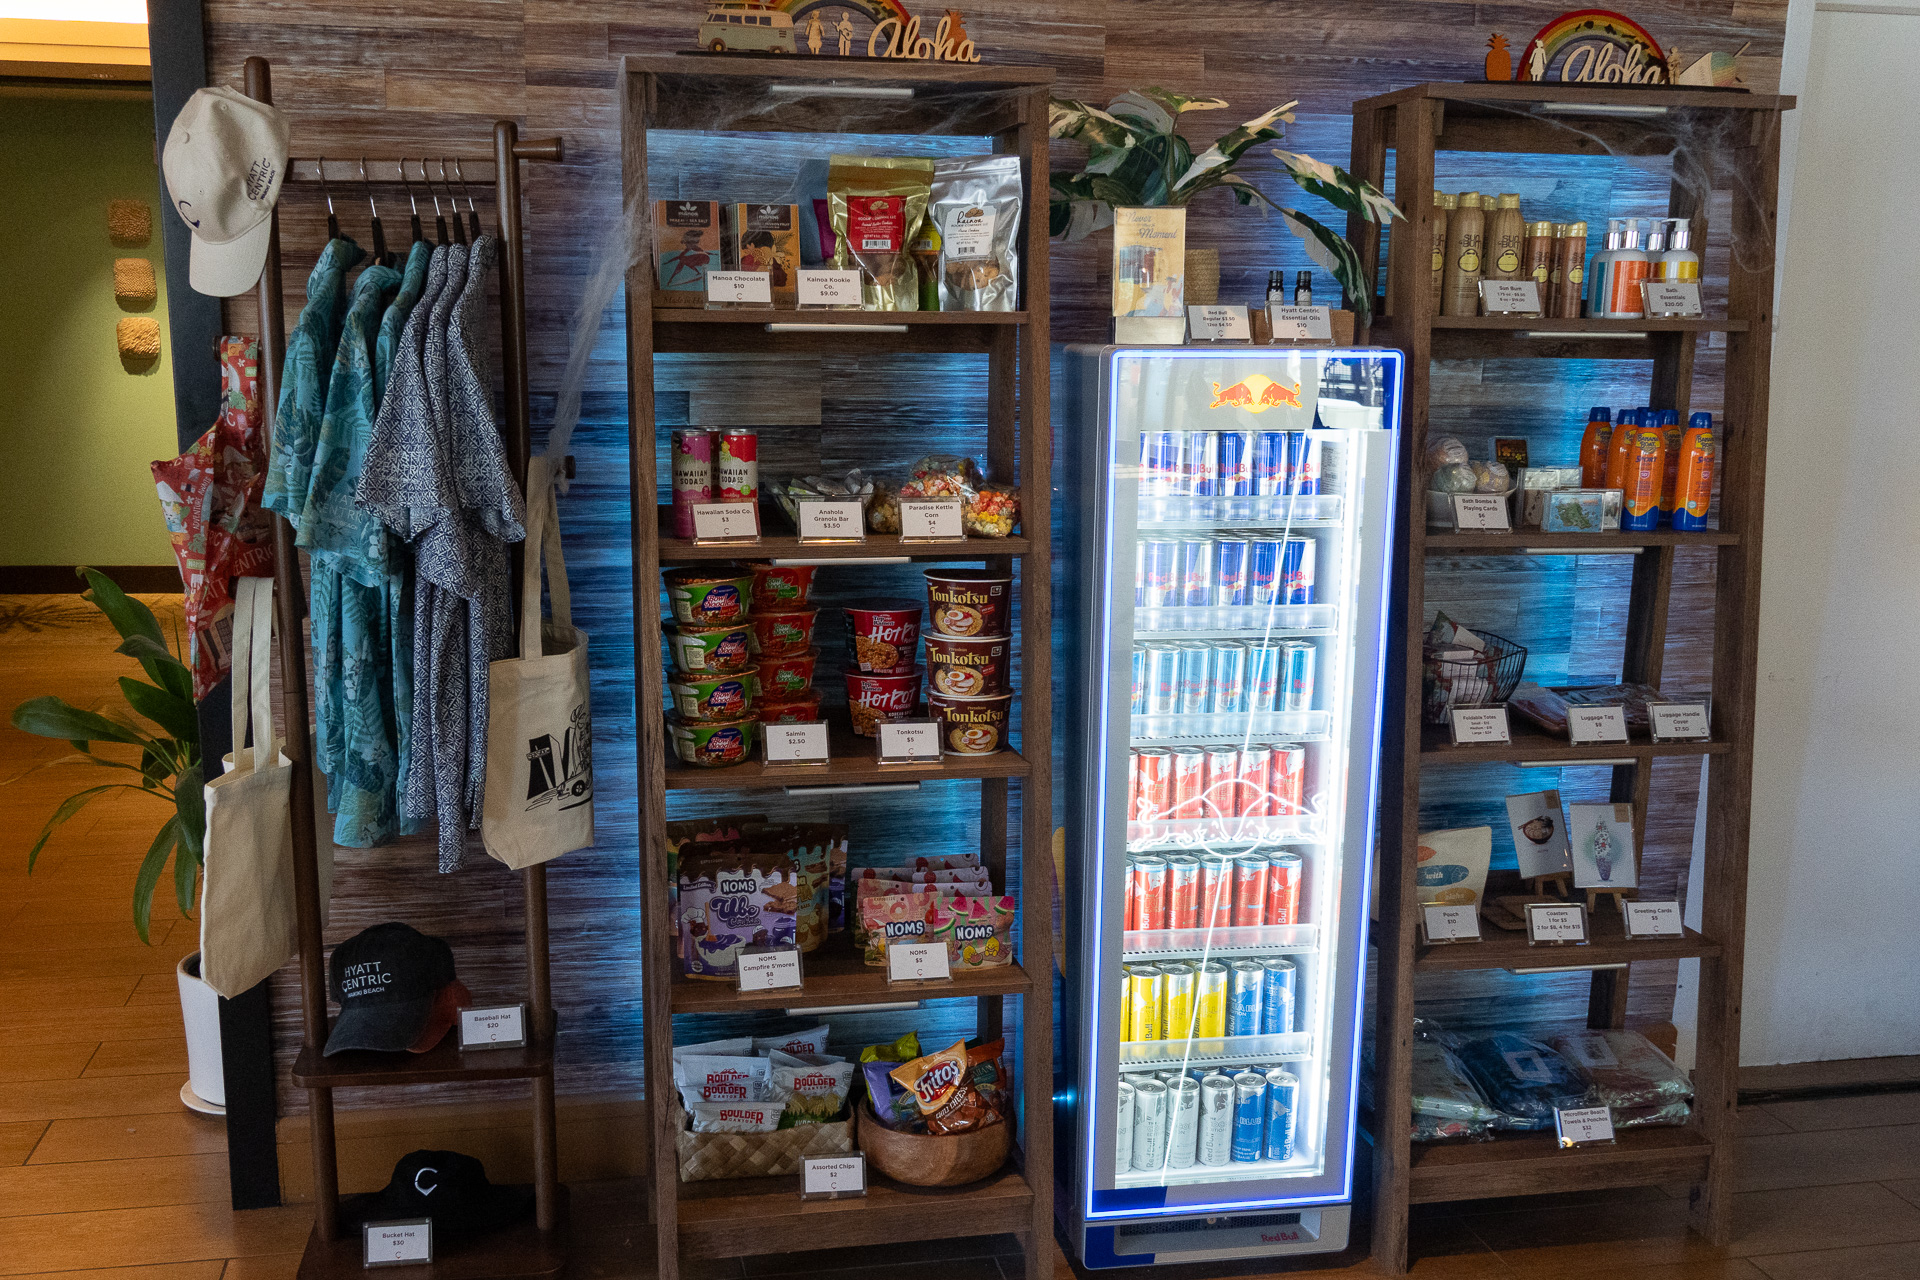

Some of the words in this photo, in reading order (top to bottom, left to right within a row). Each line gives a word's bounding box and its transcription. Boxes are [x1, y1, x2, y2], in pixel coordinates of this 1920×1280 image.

[868, 15, 981, 63] Aloha
[1561, 43, 1667, 84] Aloha
[249, 157, 271, 201] CENTRIC
[1140, 228, 1177, 239] Moment
[1637, 434, 1659, 442] BANANA
[198, 476, 212, 496] AWAITS
[192, 496, 202, 530] ADVENTURE
[1148, 572, 1168, 582] Red
[1218, 572, 1237, 582] Red
[1253, 572, 1272, 581] Red
[930, 586, 988, 604] Tonkotsu
[930, 646, 989, 666] Tonkotsu
[1184, 679, 1202, 688] Red
[1214, 679, 1232, 688] Red
[943, 706, 1004, 723] Tonkotsu
[722, 880, 756, 894] NOMS
[710, 896, 760, 921] Ube
[1278, 908, 1287, 924] Bull
[886, 922, 924, 937] NOMS
[956, 926, 994, 940] NOMS
[344, 962, 382, 978] HYATT
[342, 972, 392, 992] CENTRIC
[363, 986, 385, 994] BEACH
[794, 1076, 836, 1092] BOULDER
[914, 1060, 960, 1103] Fritos
[703, 1086, 747, 1099] BOULDER
[949, 1086, 968, 1110] CHEESE
[720, 1109, 764, 1125] BOULDER
[1240, 1116, 1262, 1125] BLUE
[1284, 1129, 1292, 1144] Bull
[1284, 1144, 1292, 1160] Red
[1261, 1233, 1280, 1243] Red
[1280, 1232, 1300, 1241] Bull
